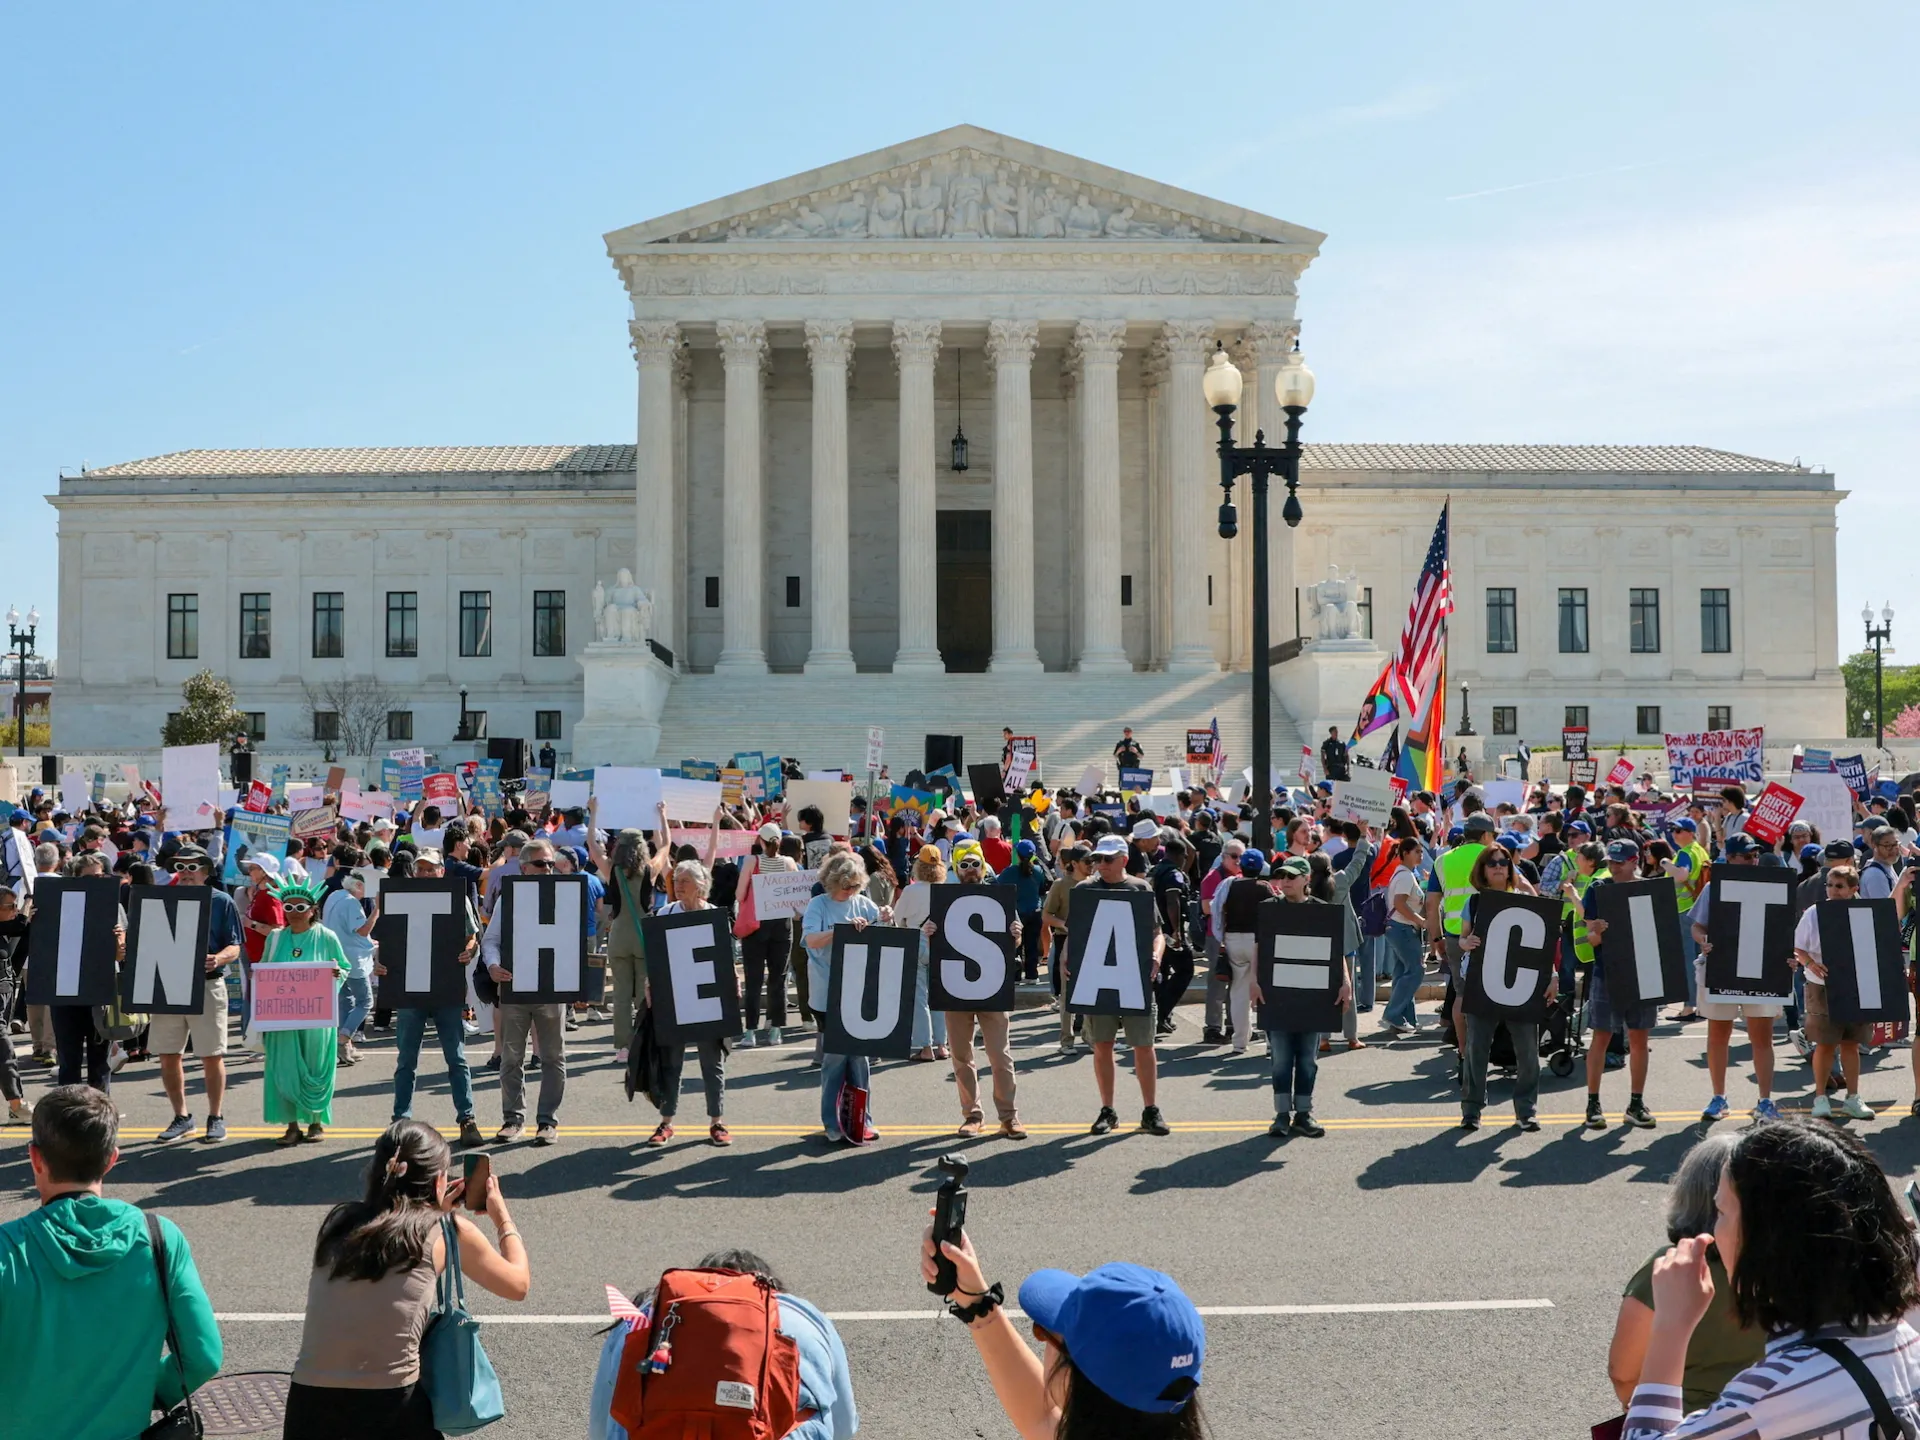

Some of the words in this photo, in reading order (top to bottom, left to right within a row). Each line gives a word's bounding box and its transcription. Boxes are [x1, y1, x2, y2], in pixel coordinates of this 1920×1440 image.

[1005, 776, 1022, 789] ALL
[1669, 761, 1763, 786] IMMIGRANTS
[1350, 802, 1387, 813] Constitution
[1355, 796, 1379, 806] literally
[1761, 793, 1796, 818] BIRTH
[1755, 804, 1790, 828] RIGHT
[800, 873, 818, 883] AQU
[512, 881, 581, 992] H
[1720, 879, 1788, 979] T
[132, 898, 201, 1006] N
[384, 891, 452, 993] T
[940, 894, 1007, 1000] S
[1069, 899, 1146, 1010] A
[1481, 907, 1546, 1007] C
[259, 968, 320, 983] CITIZENSHIP
[665, 923, 723, 1025] E
[276, 986, 285, 994] IS
[290, 985, 296, 993] A
[840, 943, 905, 1040] U
[256, 997, 324, 1015] BIRTHRIGHT
[1171, 1357, 1193, 1369] ACLU
